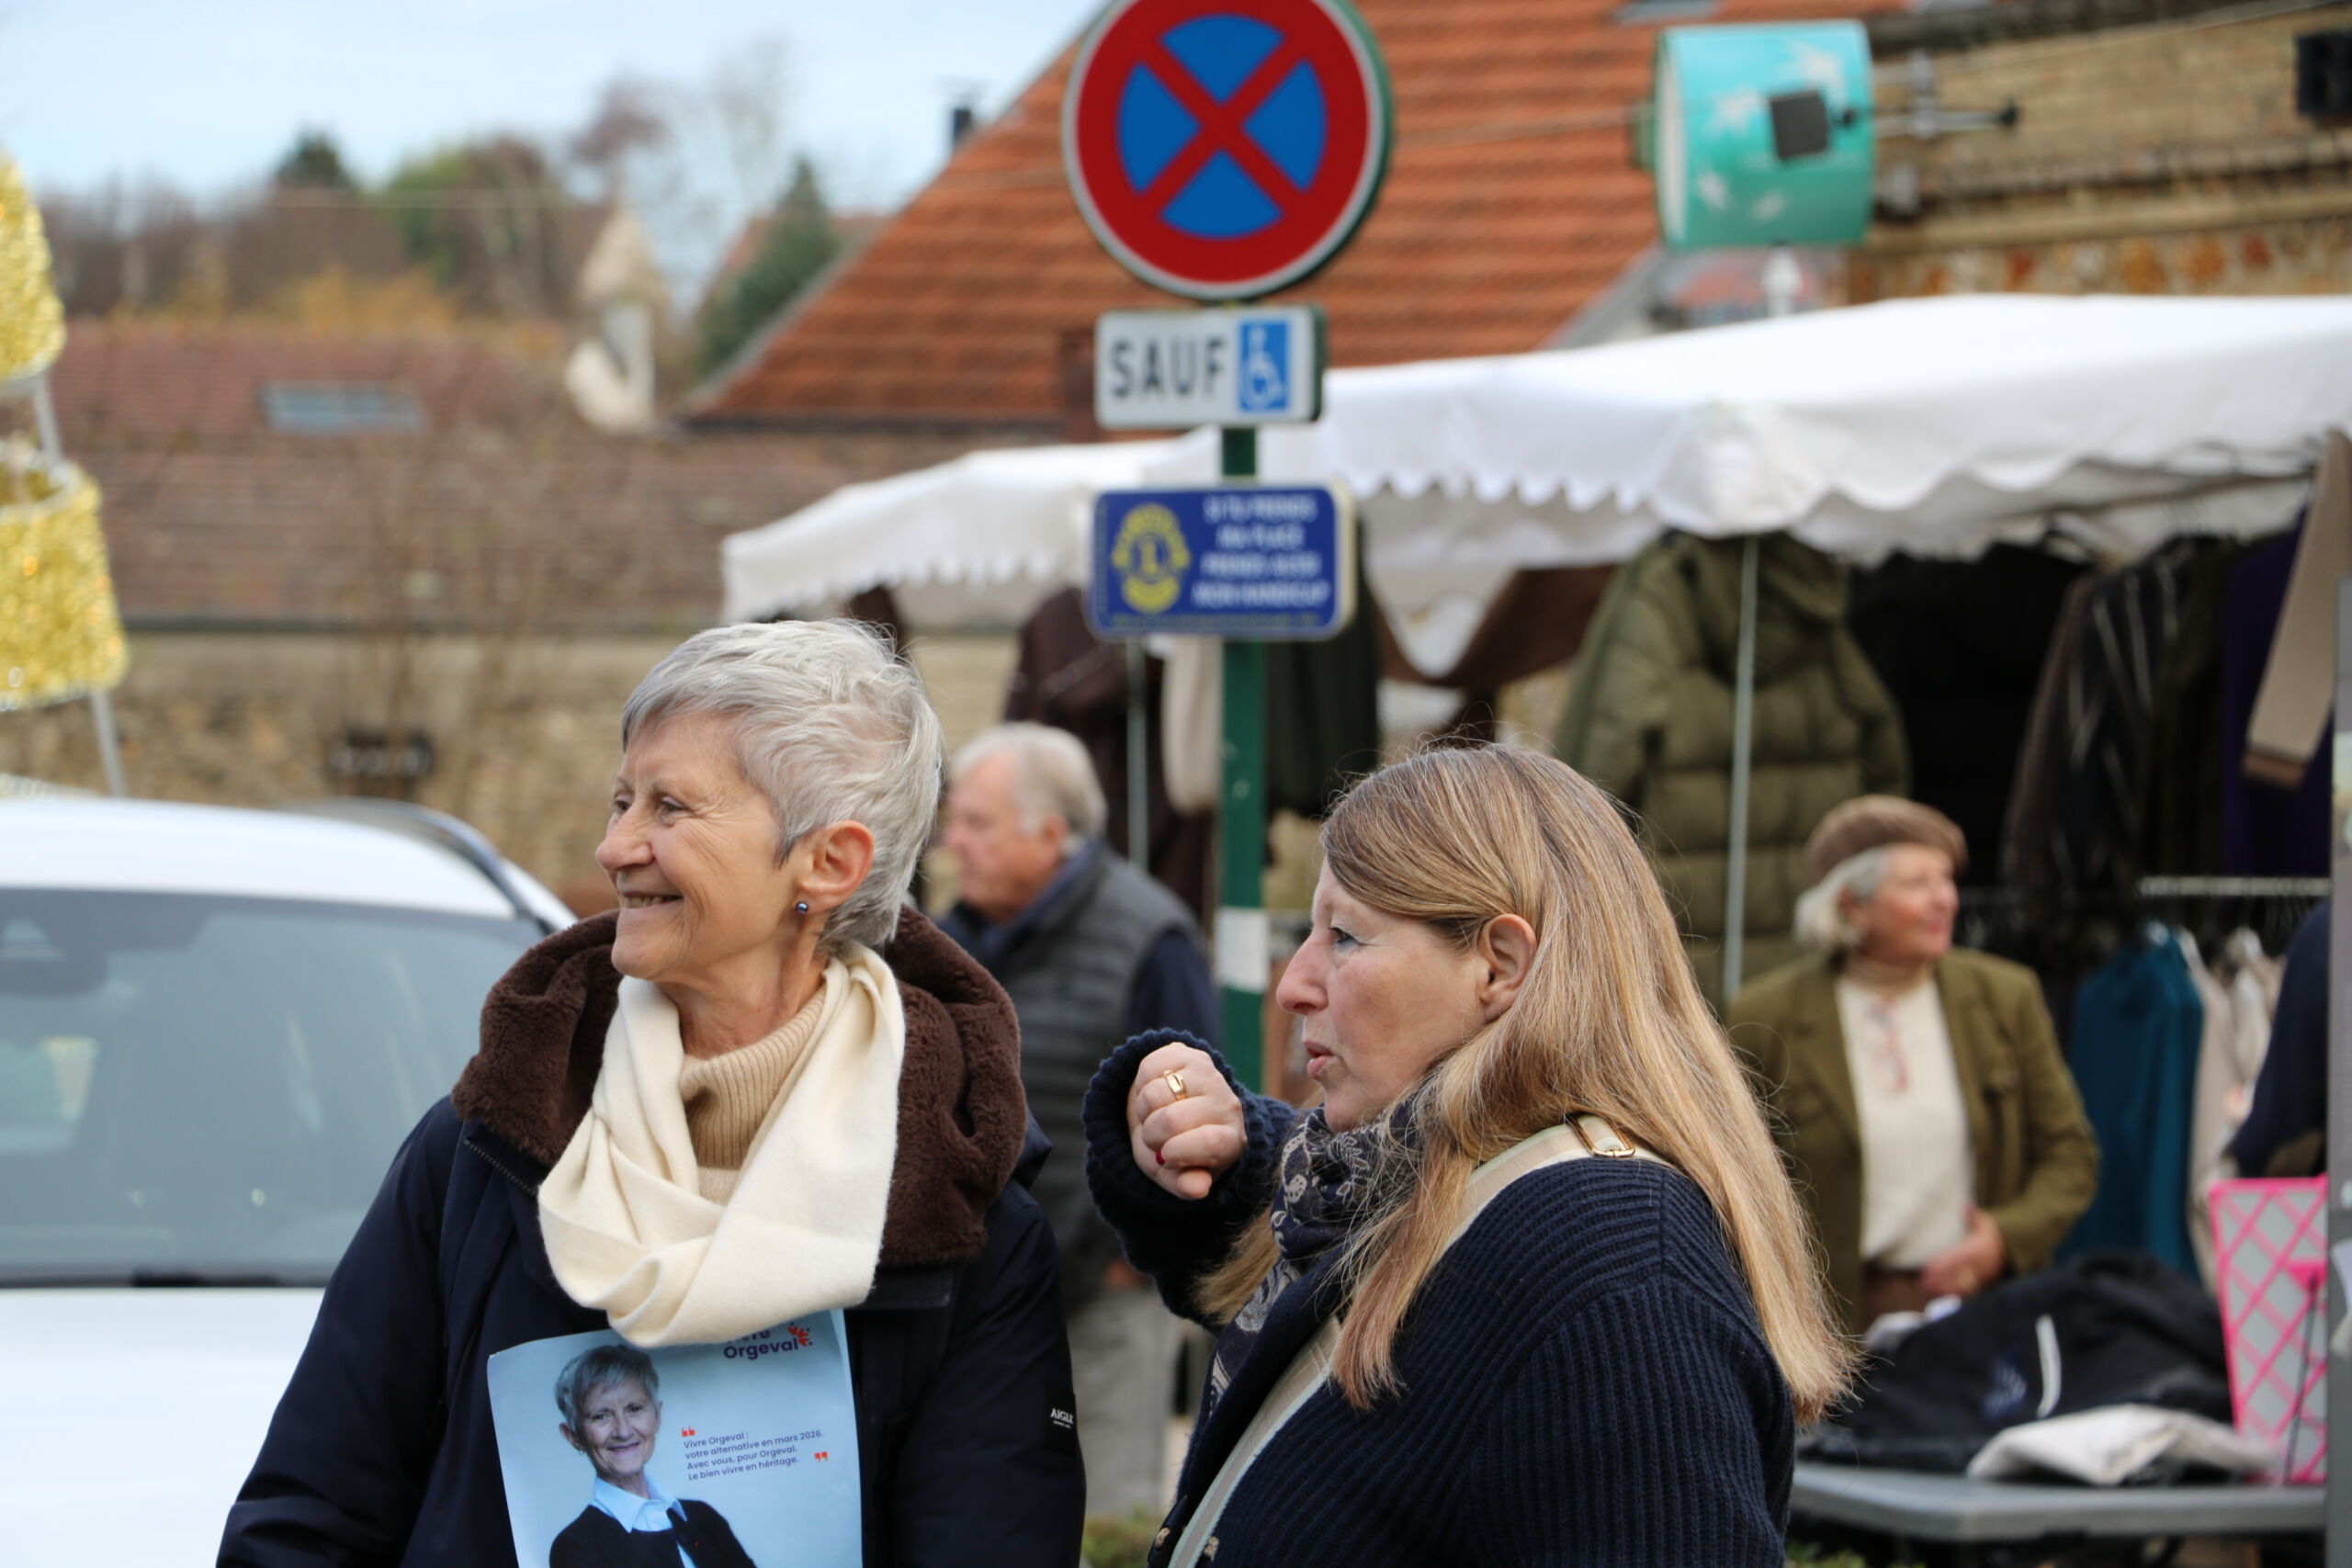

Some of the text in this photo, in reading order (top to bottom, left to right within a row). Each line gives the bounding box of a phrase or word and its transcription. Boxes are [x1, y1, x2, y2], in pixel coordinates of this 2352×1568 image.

[1111, 338, 1224, 398] SAUF
[724, 1337, 798, 1359] Orgeval
[684, 1438, 707, 1449] Vivre
[708, 1432, 744, 1445] Orgeval
[685, 1429, 824, 1460] votre alternative en mars 2026.
[687, 1445, 798, 1470] Avec vous, pour Orgeval.
[688, 1457, 799, 1481] Le bien vivre en héritage.
